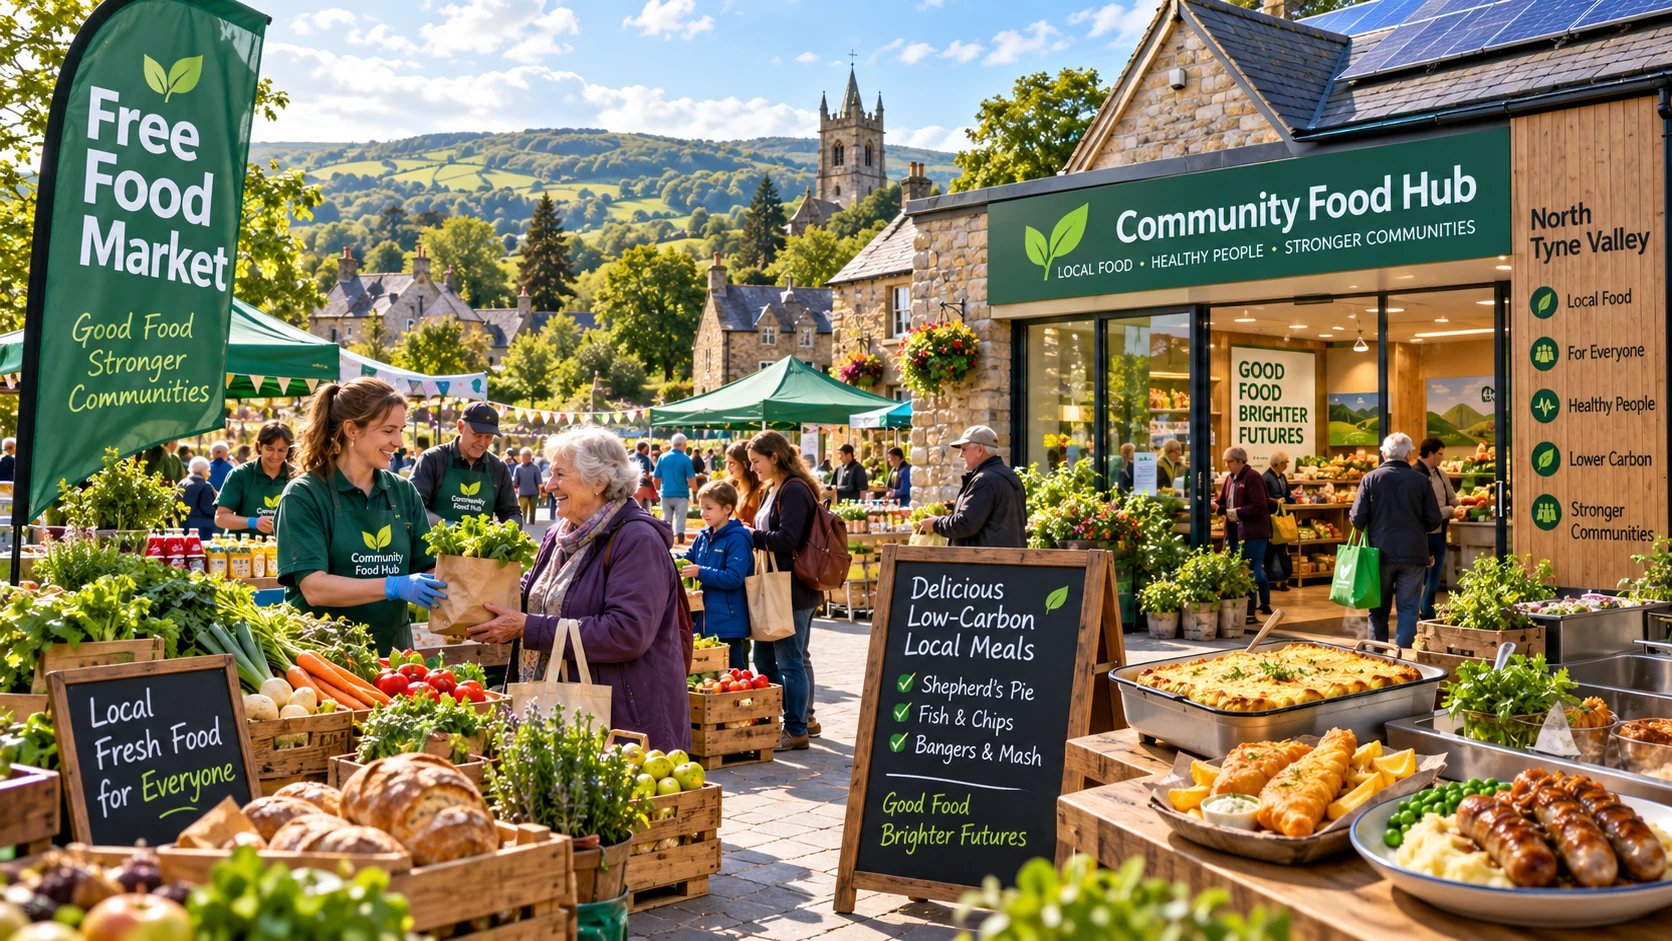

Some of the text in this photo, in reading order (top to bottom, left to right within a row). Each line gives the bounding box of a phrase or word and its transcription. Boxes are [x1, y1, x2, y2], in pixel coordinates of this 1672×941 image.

[86, 86, 199, 162] Free
[84, 149, 214, 227] Food
[1116, 164, 1477, 243] Community Food Hub
[1531, 202, 1591, 231] North
[80, 214, 228, 292] Market
[1058, 219, 1476, 279] LOCAL FOOD HEALTHY PEOPLE STRONGER COMMUNITIES
[1530, 227, 1650, 264] Tyne Valley
[1567, 287, 1632, 308] Local Food
[72, 312, 194, 348] Good Food
[88, 349, 187, 382] Stronger
[1568, 344, 1645, 363] For Everyone
[1239, 360, 1285, 380] GOOD
[69, 379, 209, 412] Communities
[1239, 382, 1282, 401] FOOD
[1569, 395, 1655, 416] Healthy People
[1239, 405, 1308, 423] BRIGHTER
[1239, 426, 1304, 444] FUTURES
[1570, 450, 1652, 467] Lower Carbon
[1571, 501, 1625, 521] Stronger
[1571, 523, 1654, 542] Communities
[351, 552, 403, 564] Community
[356, 564, 400, 575] Food Hub
[911, 575, 1004, 600] Delicious
[907, 604, 1034, 630] Low-Carbon
[904, 632, 1034, 661] Local Meals
[921, 675, 1034, 701] Shepherd's Pie
[90, 687, 154, 728] Local
[919, 704, 1013, 736] Fish & Chips
[94, 715, 223, 770] Fresh Food
[915, 734, 1041, 767] Bangers & Mash
[97, 763, 236, 818] for Everyone
[883, 791, 971, 817] Good Food
[880, 822, 1027, 855] Brighter Futures
